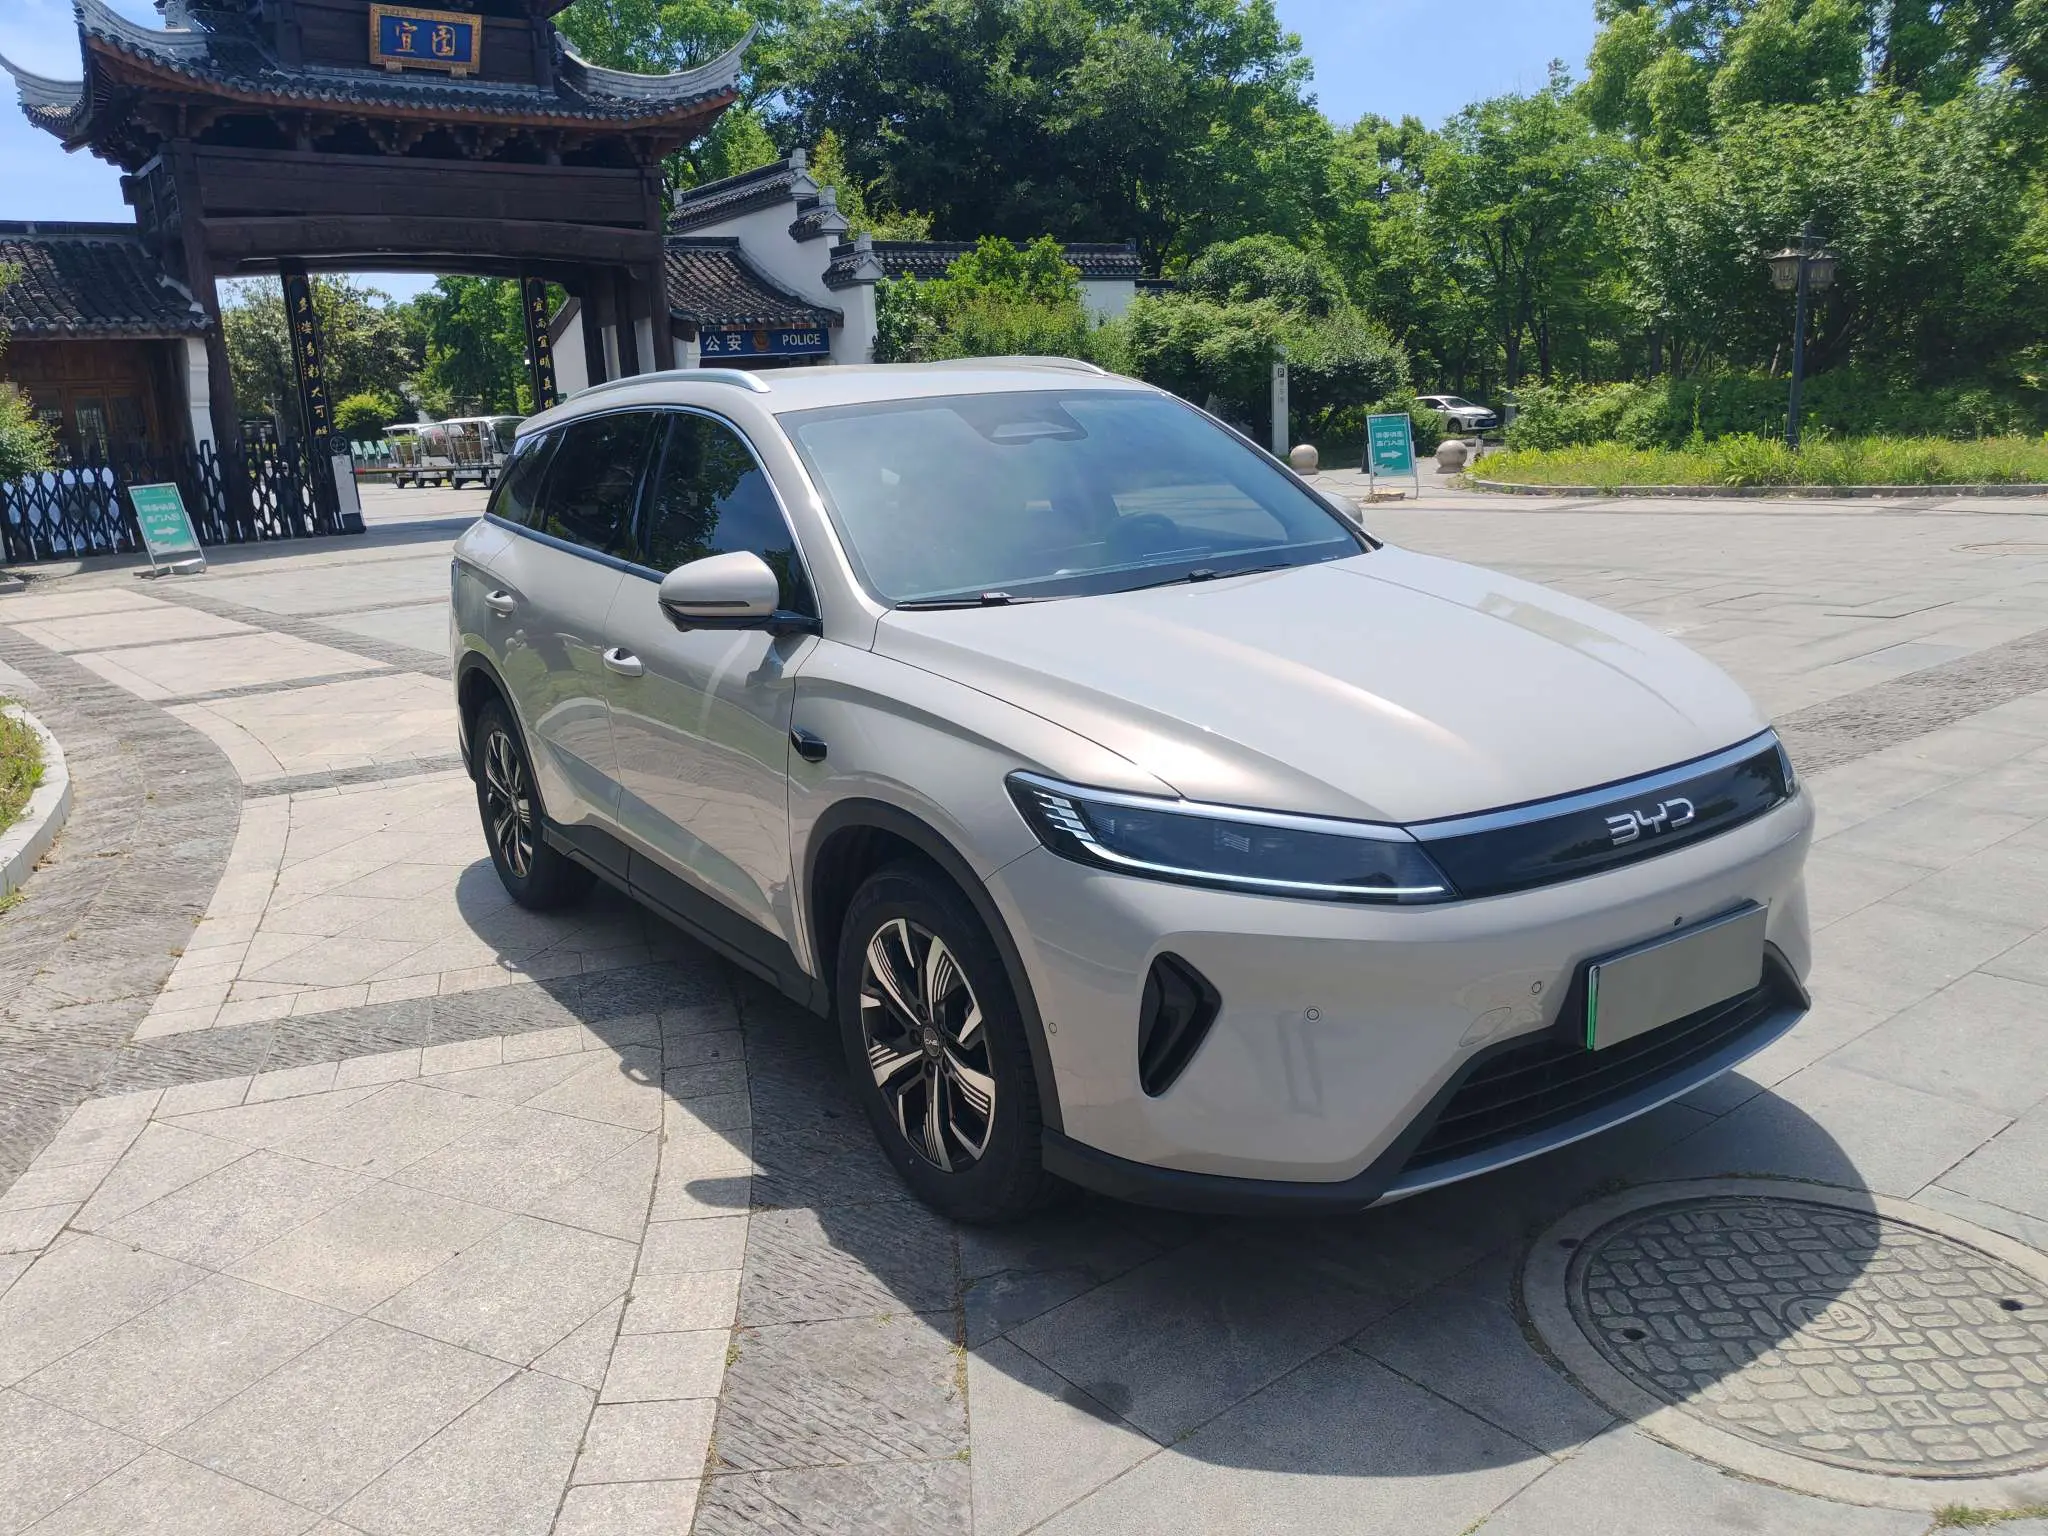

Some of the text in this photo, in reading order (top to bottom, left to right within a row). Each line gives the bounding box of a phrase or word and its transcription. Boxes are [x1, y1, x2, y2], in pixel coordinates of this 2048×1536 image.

[705, 334, 742, 352] 公安
[782, 333, 821, 346] POLICE
[1605, 798, 1694, 846] BYD
